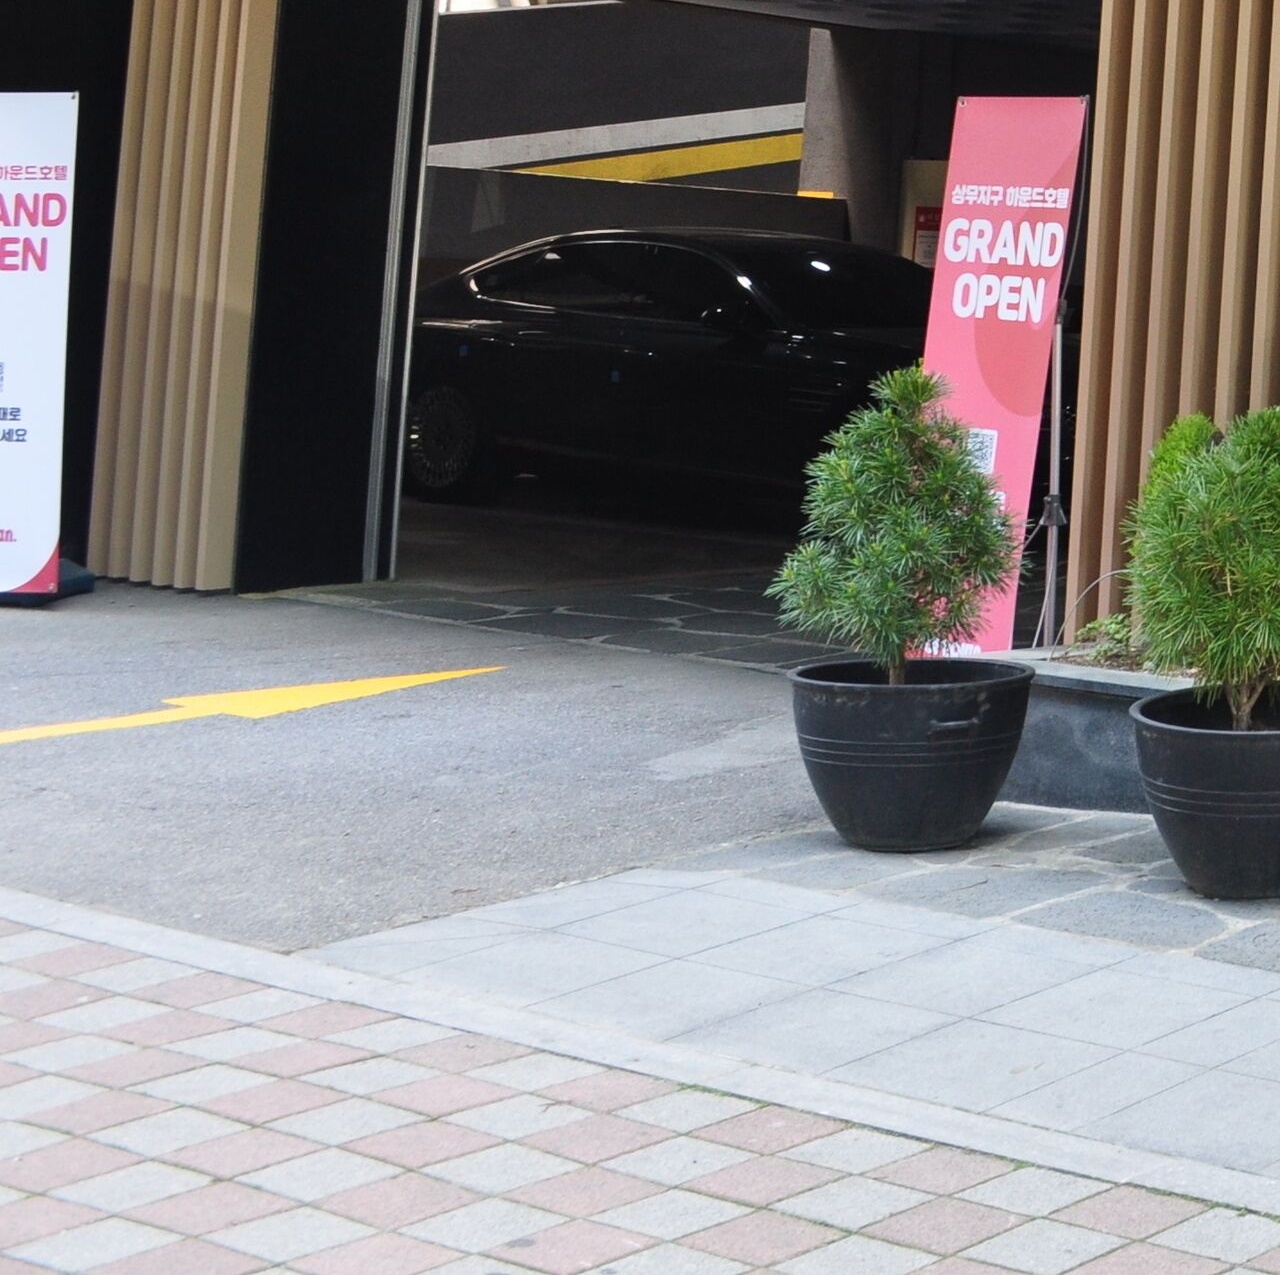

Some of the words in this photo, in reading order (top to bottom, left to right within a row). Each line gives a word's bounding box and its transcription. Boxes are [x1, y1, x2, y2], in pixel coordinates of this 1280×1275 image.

[951, 183, 1004, 207] 상무지구
[1005, 185, 1070, 209] 하운드호텔
[944, 217, 1065, 269] GRAND
[952, 272, 1046, 324] OPEN
